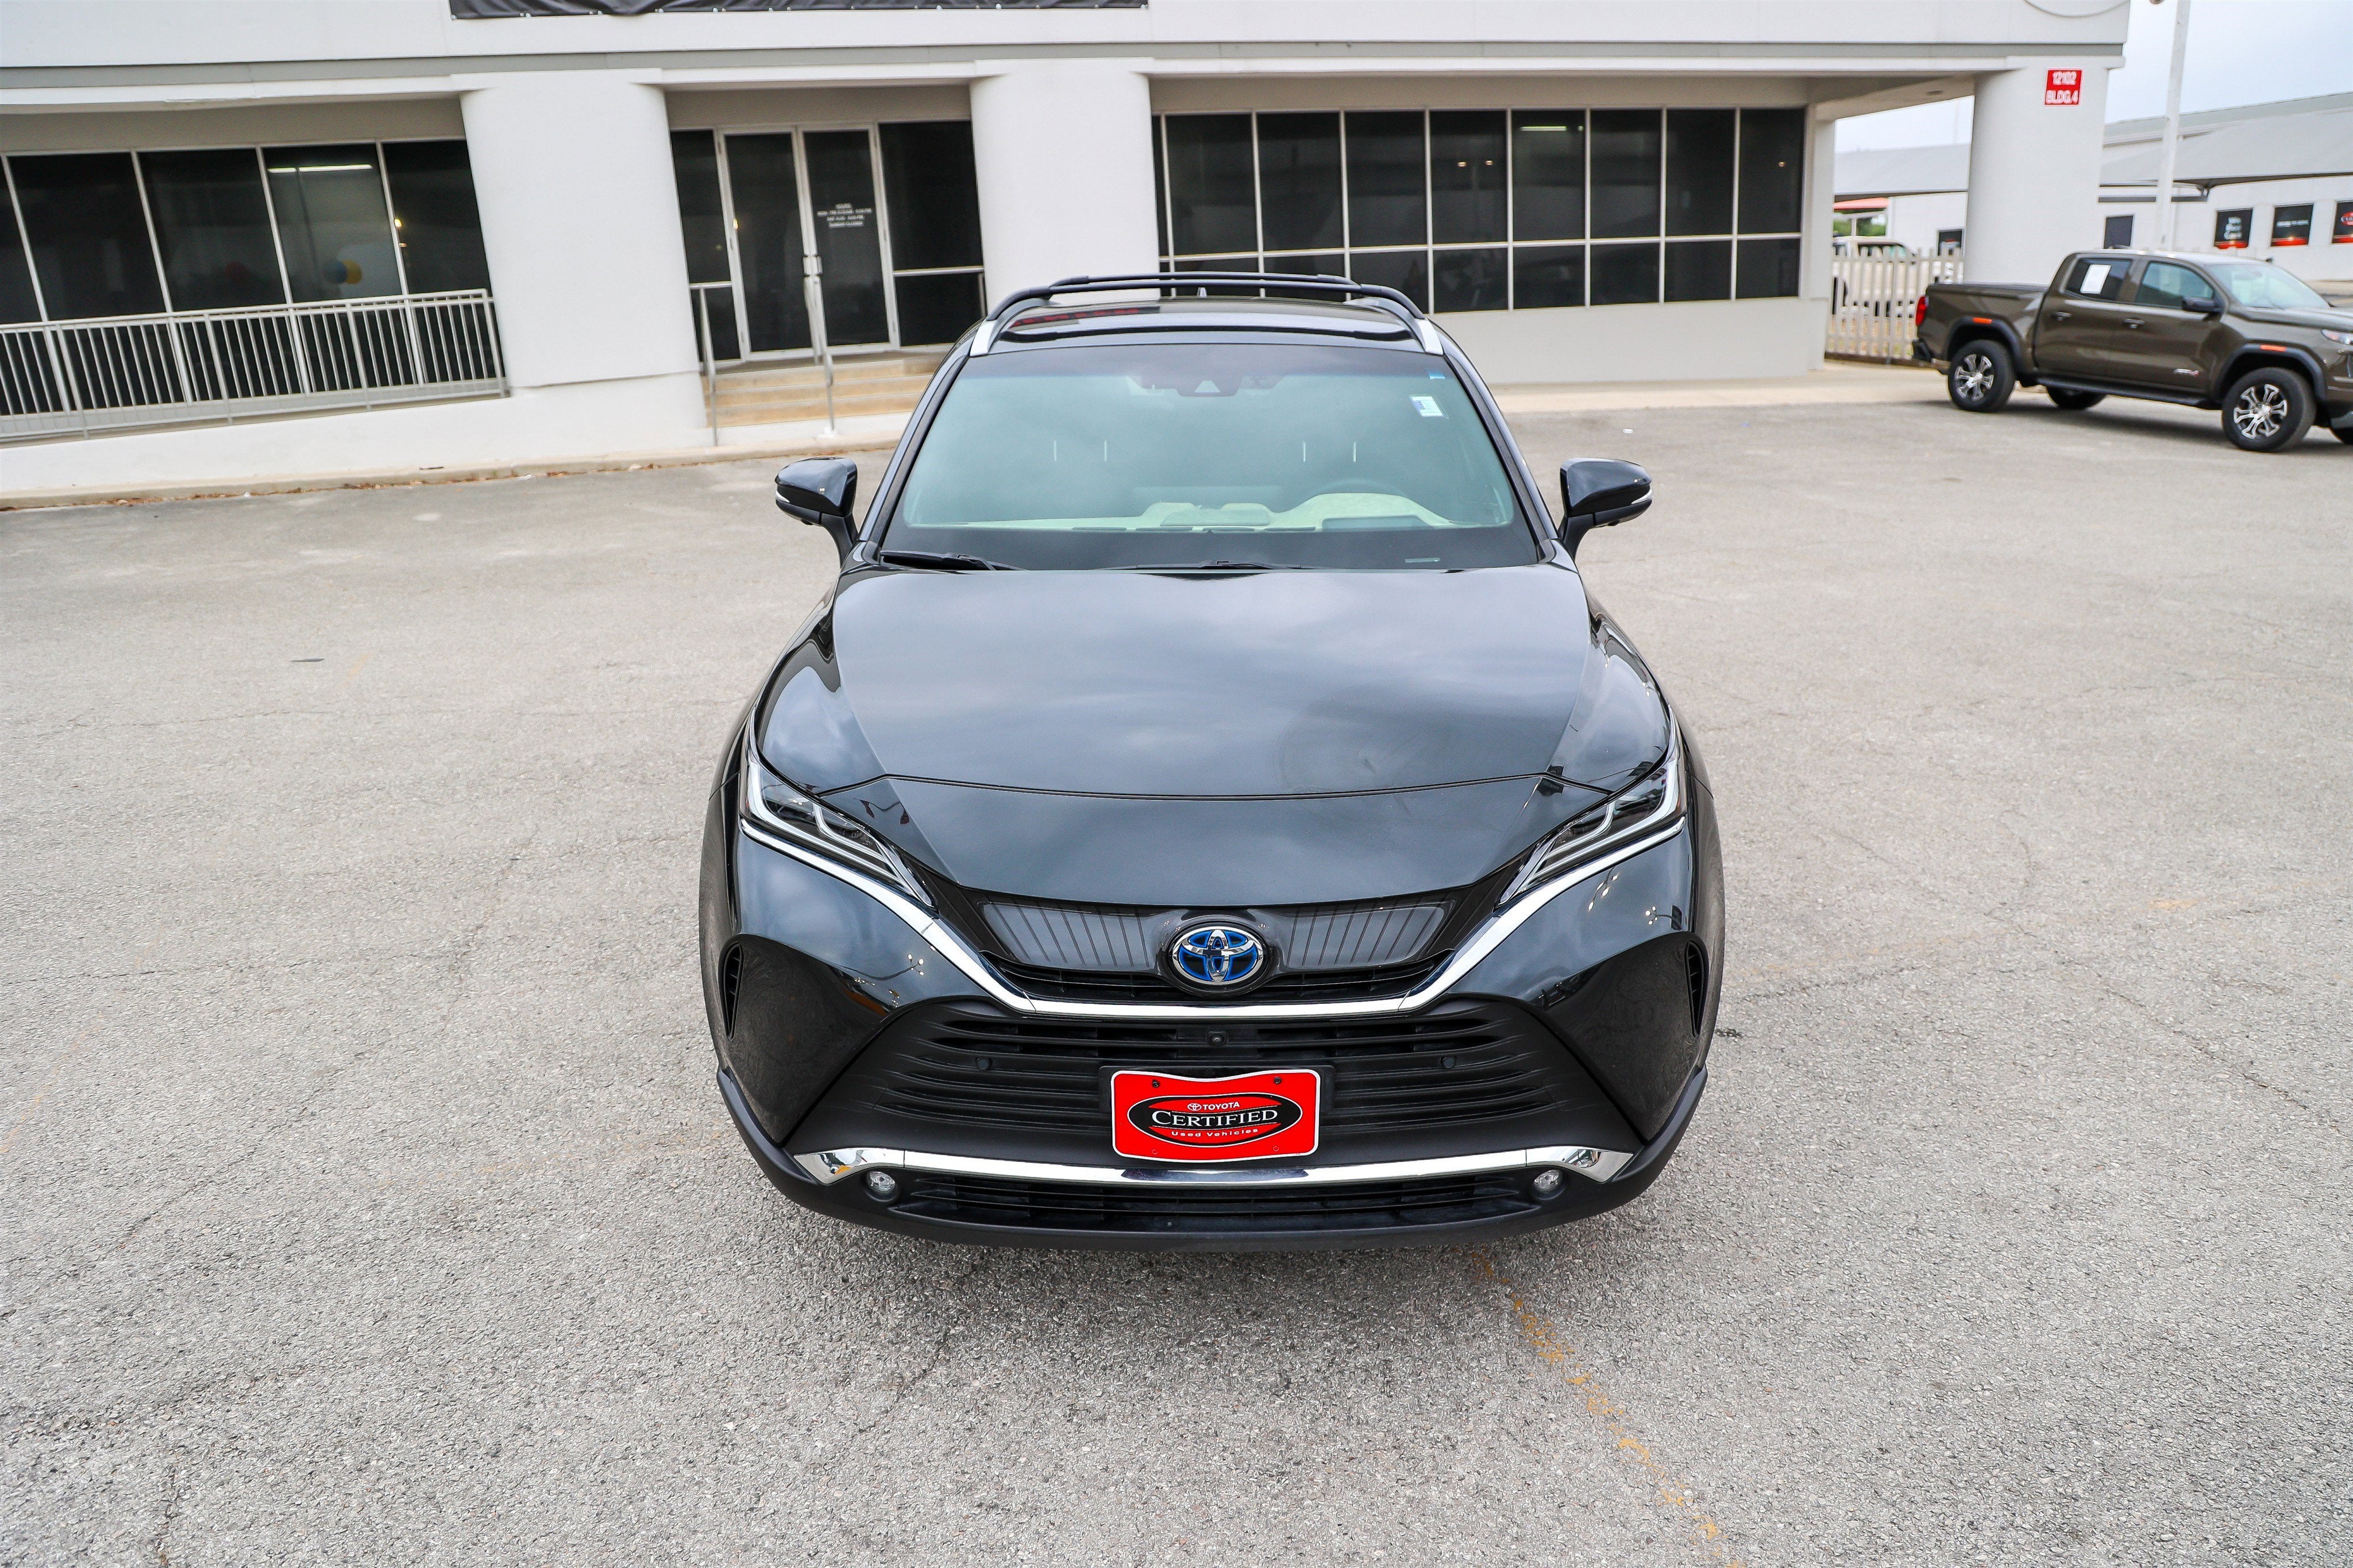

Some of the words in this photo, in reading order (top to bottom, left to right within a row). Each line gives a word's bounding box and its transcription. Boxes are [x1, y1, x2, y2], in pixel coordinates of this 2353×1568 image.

[2046, 90, 2071, 104] BLDG
[1202, 1102, 1240, 1110] TOYOTA
[1152, 1110, 1278, 1126] CERTIFIED
[1206, 1129, 1258, 1137] Vehicles
